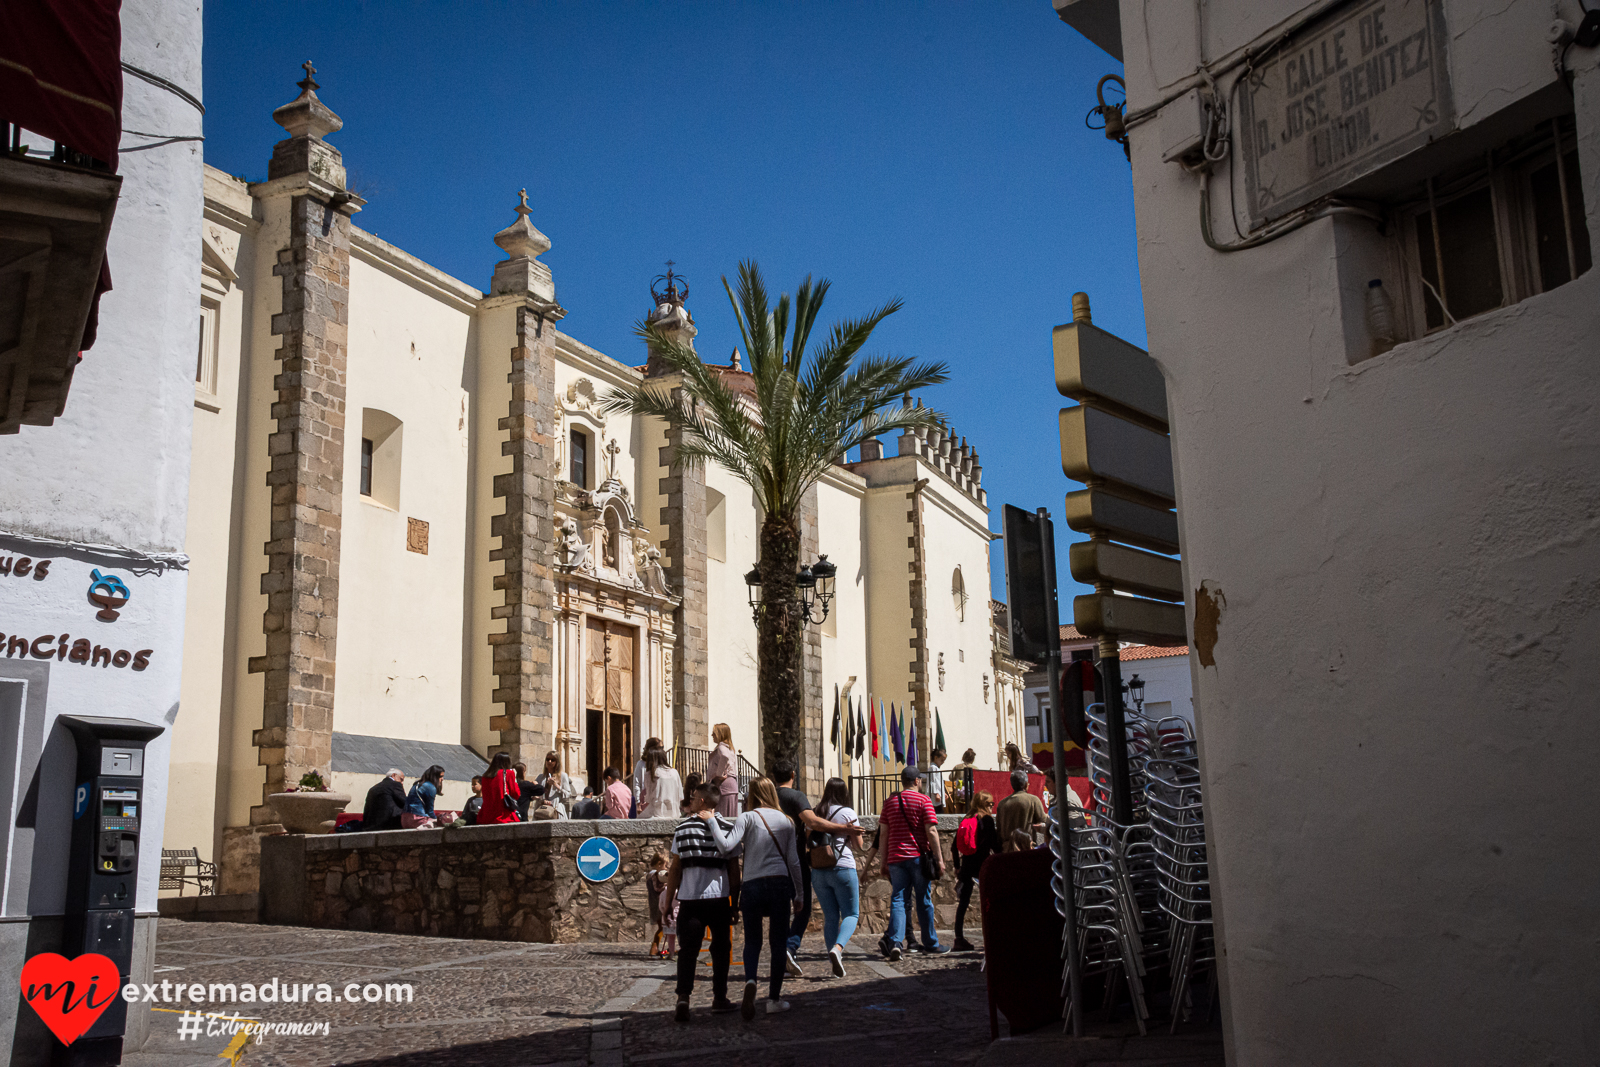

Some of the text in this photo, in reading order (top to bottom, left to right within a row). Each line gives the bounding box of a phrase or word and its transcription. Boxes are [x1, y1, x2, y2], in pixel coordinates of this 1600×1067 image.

[1257, 27, 1429, 158] D. JOSE BENITEZ
[1285, 29, 1348, 98] CALLE
[76, 787, 87, 813] P
